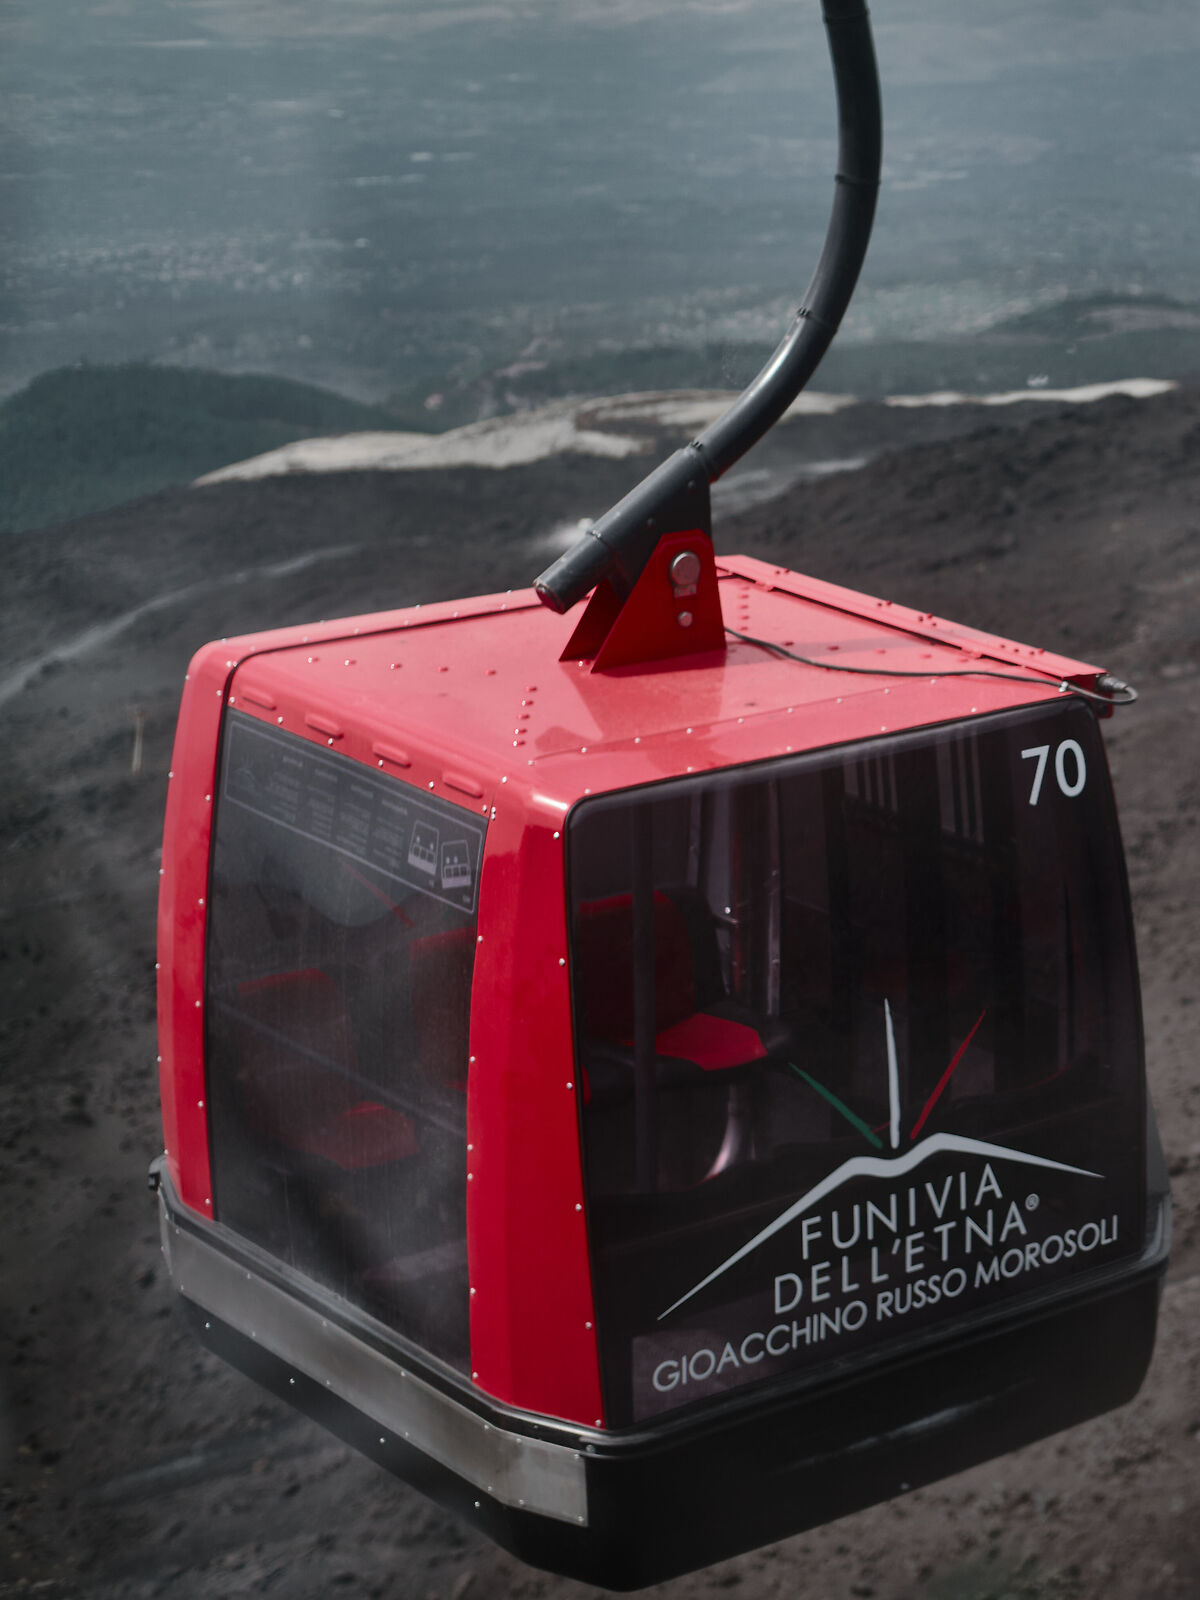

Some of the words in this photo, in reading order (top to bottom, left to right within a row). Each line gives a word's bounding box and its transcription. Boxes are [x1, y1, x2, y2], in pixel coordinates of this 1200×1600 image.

[1021, 739, 1087, 806] 70
[801, 1163, 1003, 1260] FUNIVIA
[652, 1300, 867, 1393] GIOACCHINO
[876, 1268, 967, 1321] RUSSO
[974, 1214, 1119, 1288] MOROSOLI
